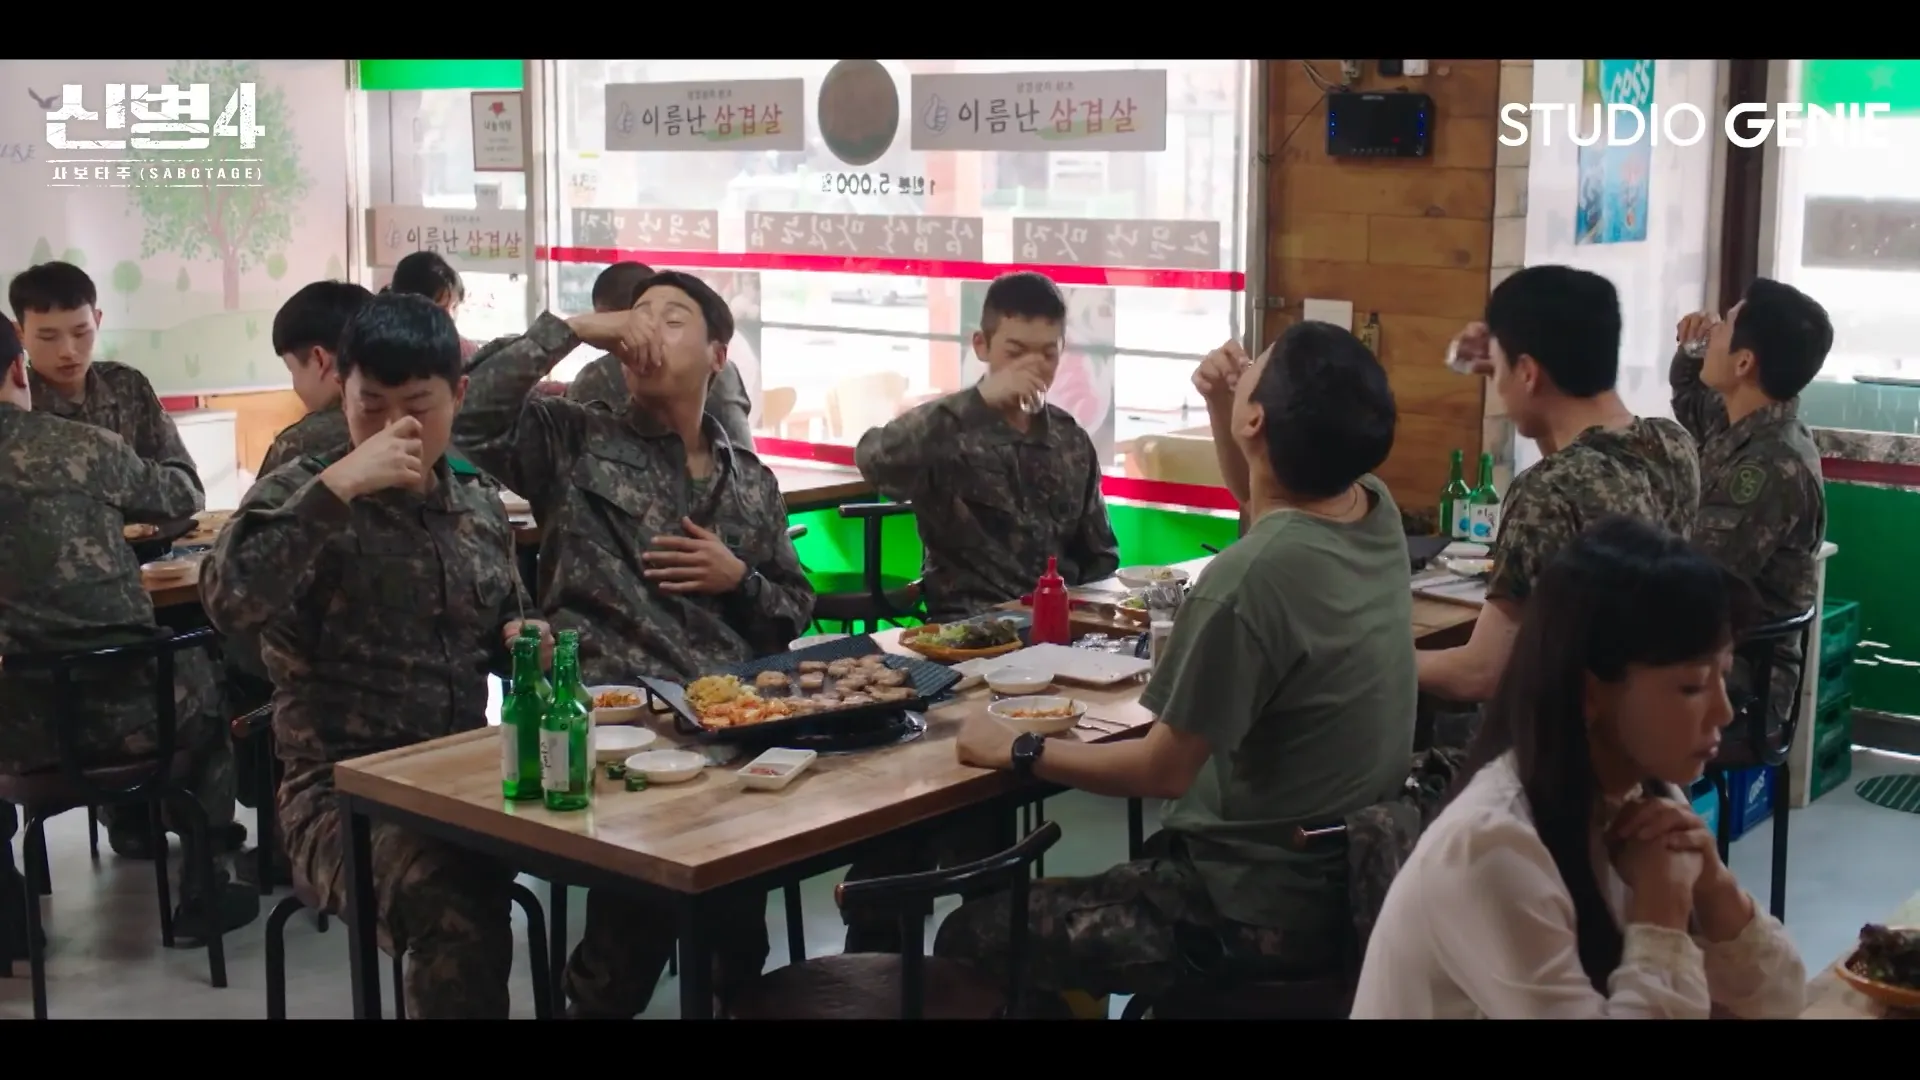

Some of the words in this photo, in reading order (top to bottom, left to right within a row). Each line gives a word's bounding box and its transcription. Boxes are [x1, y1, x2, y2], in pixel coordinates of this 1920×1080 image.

[641, 104, 707, 136] 이름난
[713, 103, 783, 135] 삼겹살
[957, 97, 1040, 134] 이름난
[1049, 97, 1138, 134] 삼겹살
[466, 229, 522, 259] 삼겹살
